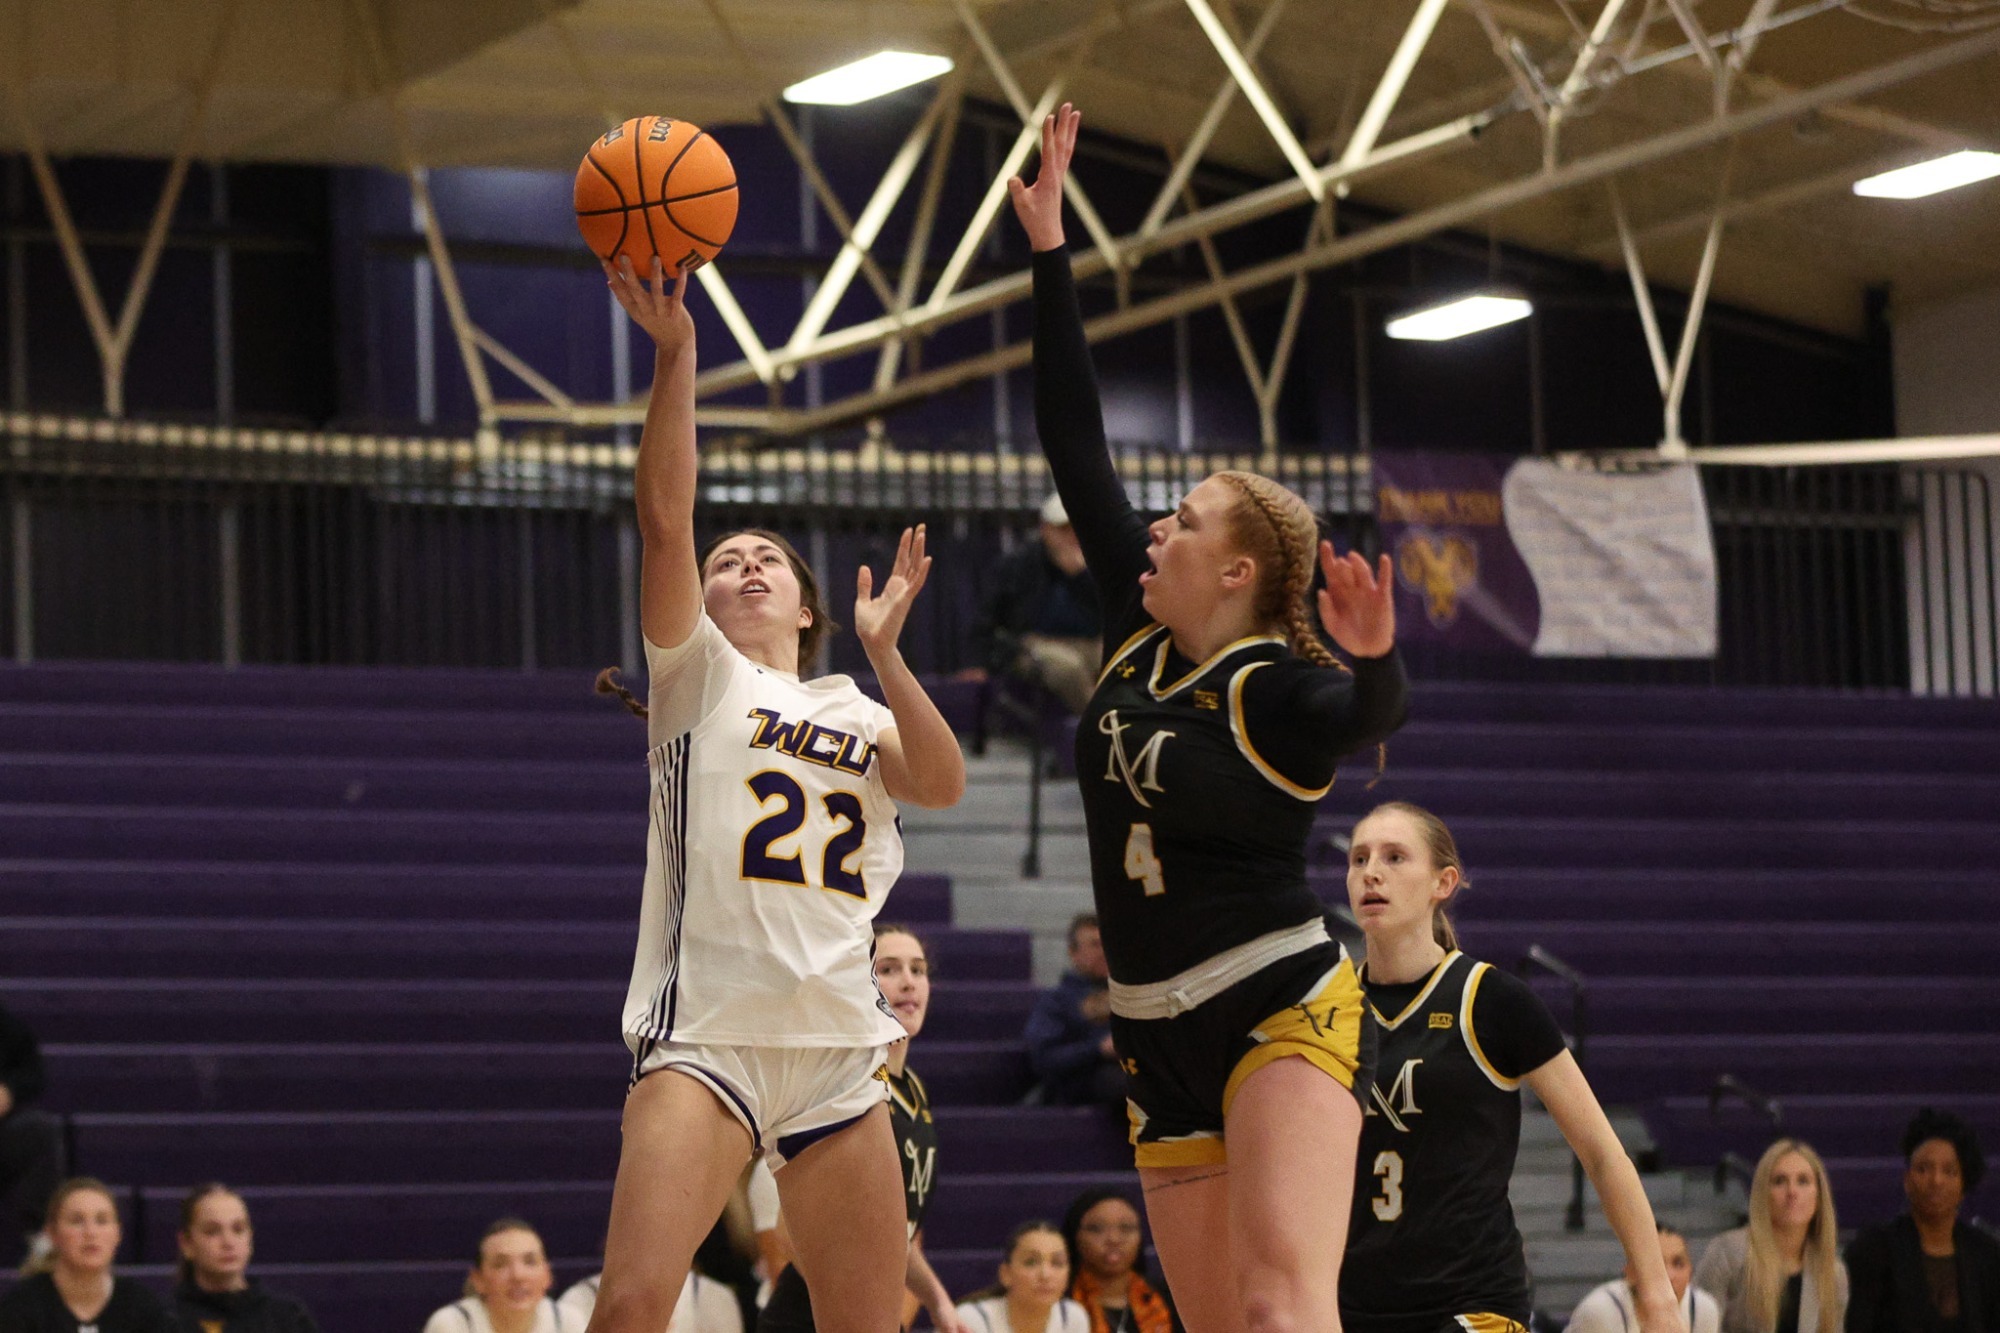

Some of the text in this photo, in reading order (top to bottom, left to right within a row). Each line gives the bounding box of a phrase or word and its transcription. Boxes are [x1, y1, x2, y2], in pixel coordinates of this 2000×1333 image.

[747, 708, 878, 777] WCU
[739, 768, 869, 902] 22
[1124, 822, 1166, 897] 4
[1371, 1150, 1405, 1222] 3
